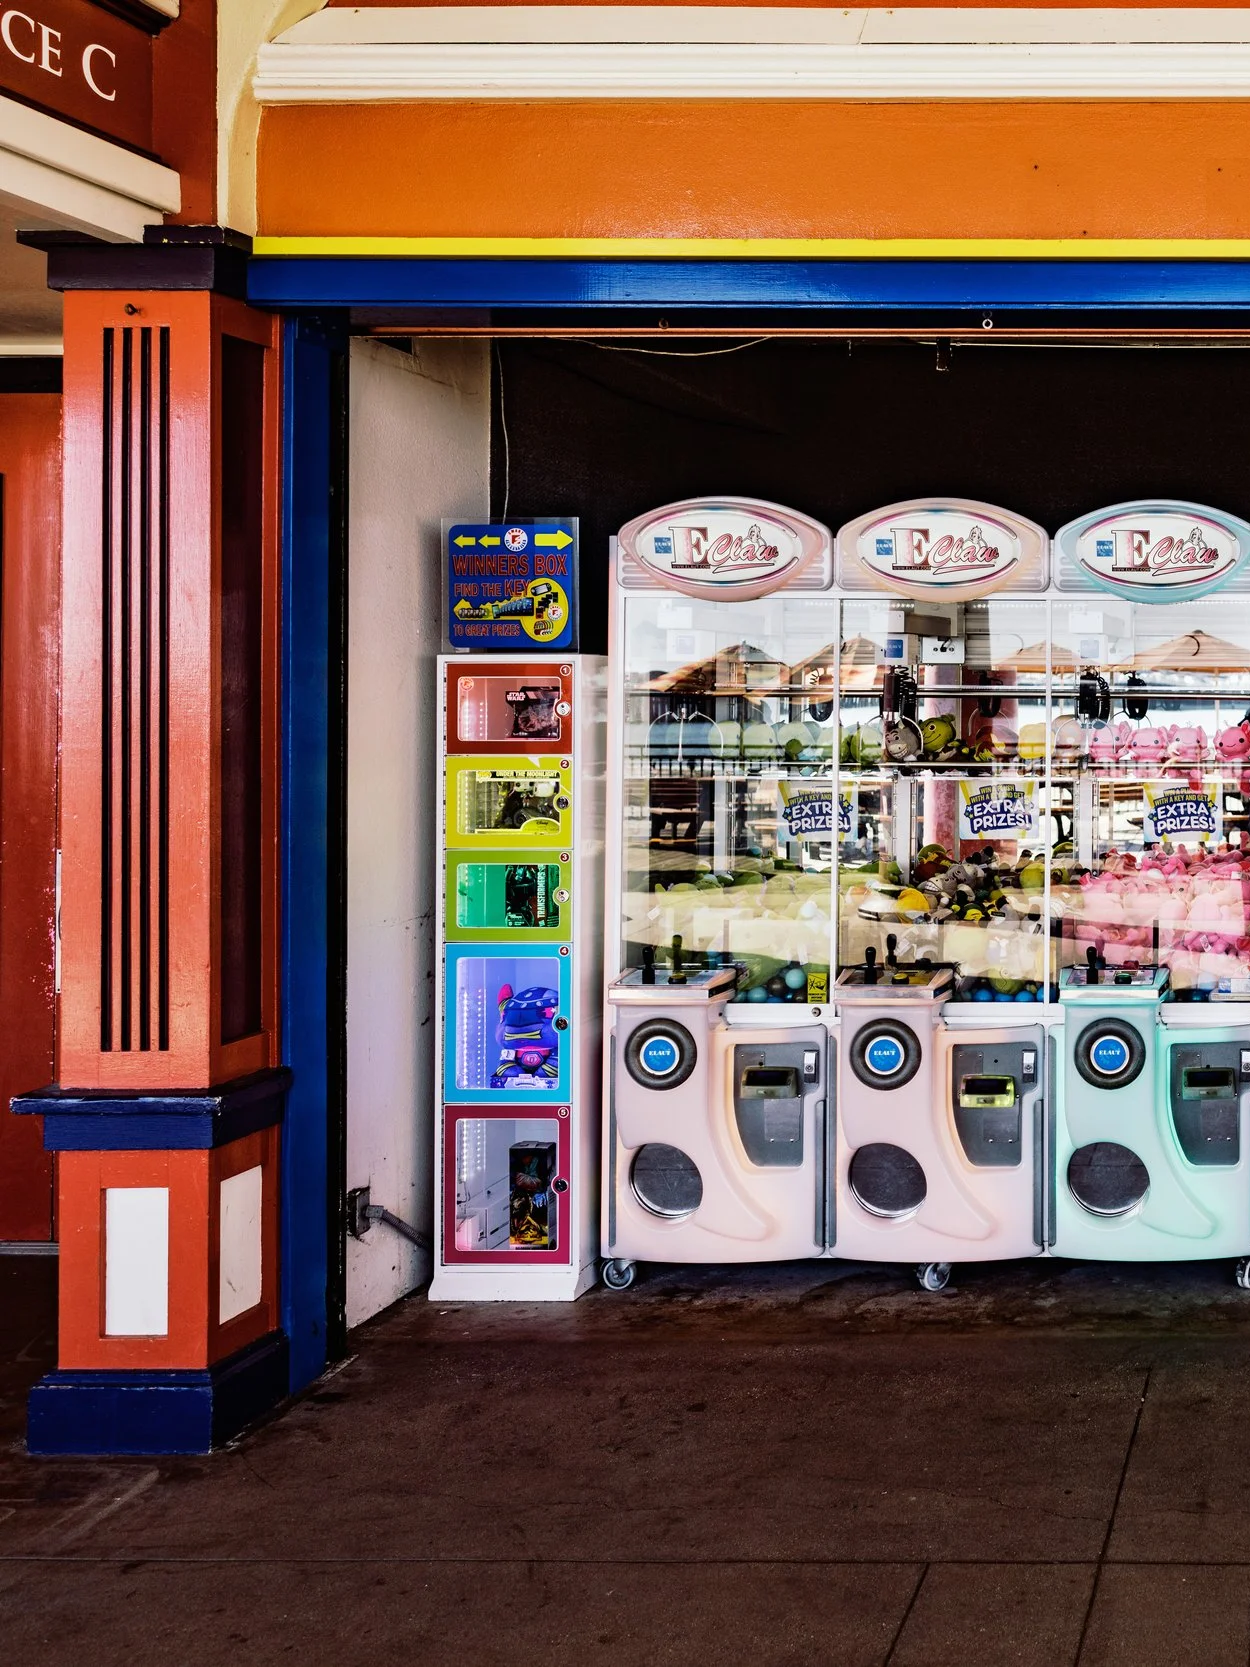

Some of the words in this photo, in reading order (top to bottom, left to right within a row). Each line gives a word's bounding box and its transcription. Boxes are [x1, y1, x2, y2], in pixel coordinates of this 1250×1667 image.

[0, 10, 62, 77] CE
[82, 43, 116, 101] C
[452, 554, 529, 576] WINNERS
[534, 554, 568, 576] BOX
[454, 583, 479, 597] FIND
[481, 583, 502, 597] THE
[504, 579, 532, 597] KEY
[453, 624, 464, 636] TO
[466, 624, 490, 636] GREAT
[492, 624, 520, 636] PRIZES
[981, 785, 992, 794] WIN
[971, 795, 984, 803] WITH
[973, 799, 1025, 817] EXTRA
[1155, 797, 1169, 806] WITH
[1157, 801, 1209, 819] EXTRA
[973, 813, 1029, 831] PRIZES!
[1157, 816, 1213, 834] PRIZES!
[537, 872, 546, 918] TRANSFORMERS
